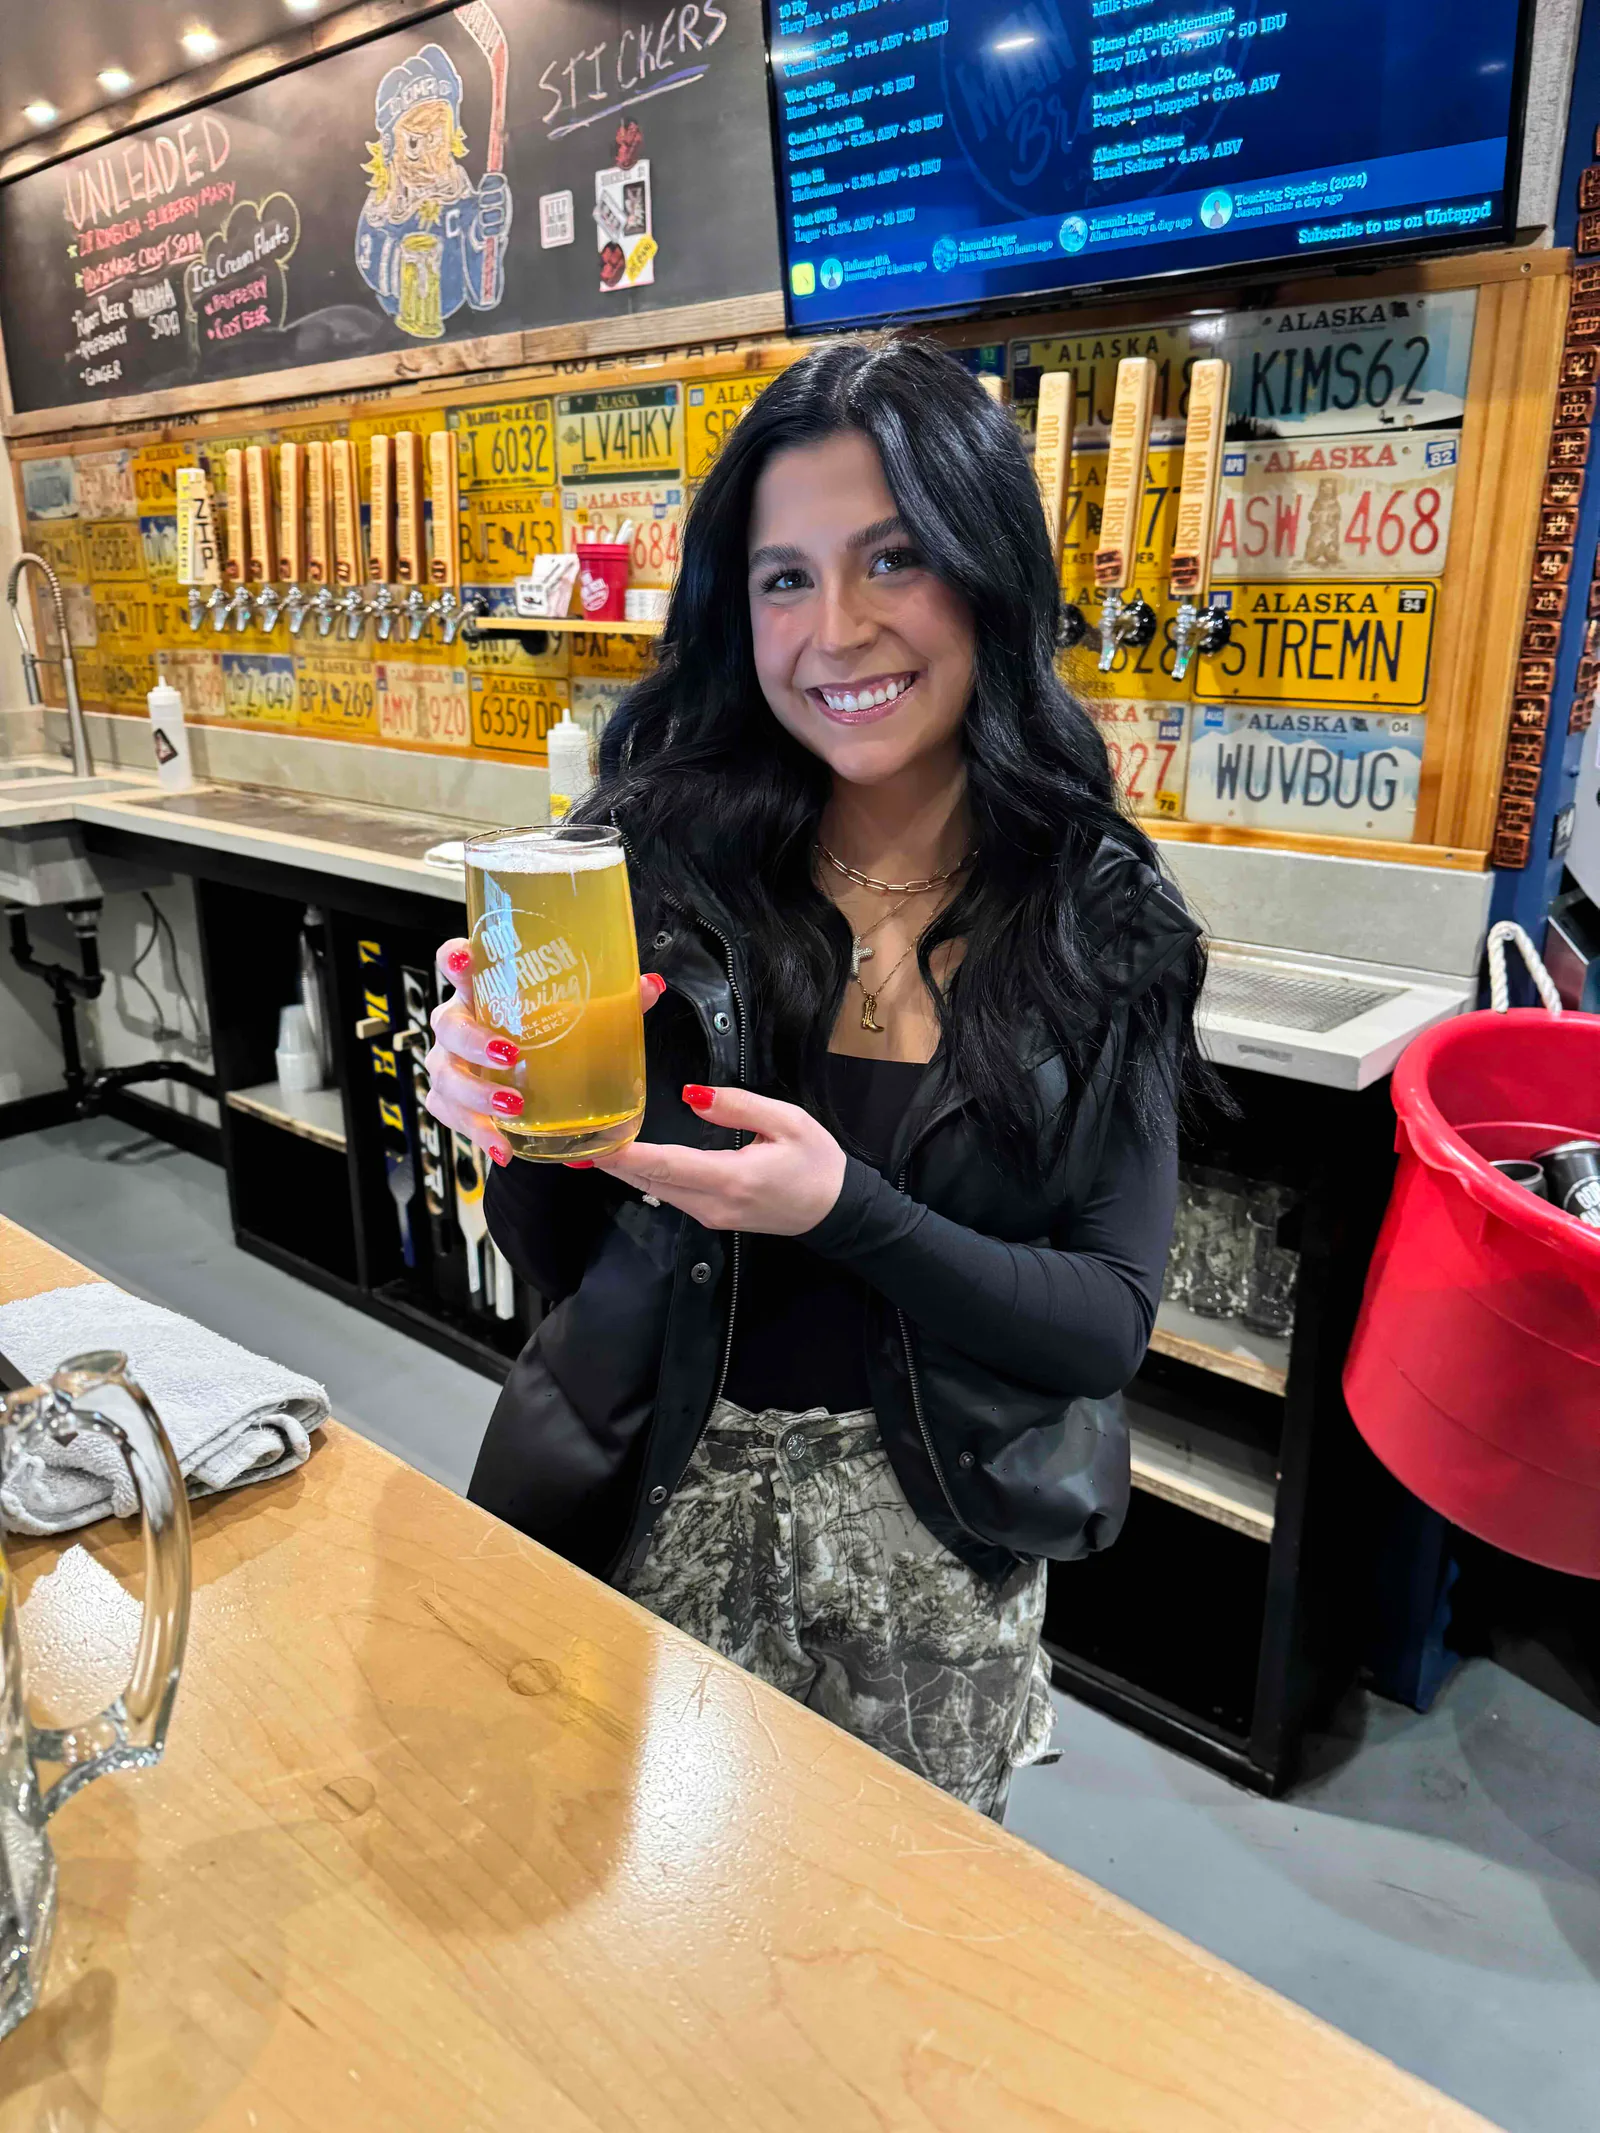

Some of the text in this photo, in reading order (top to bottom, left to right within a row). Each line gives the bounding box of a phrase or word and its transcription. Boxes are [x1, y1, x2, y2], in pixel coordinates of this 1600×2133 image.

[779, 1, 808, 19] 10 Ply
[780, 19, 804, 36] Hazy
[805, 12, 824, 28] IPA
[1092, 1, 1121, 18] Milk
[783, 19, 949, 78] Vanilla Porter 5.7% ABV 24 IBU
[1092, 6, 1236, 56] Plane of Enlightenment
[1092, 13, 1288, 74] Hazy IPA 6.7% ABV 50 IBU
[539, 0, 728, 125] STICKERS
[826, 92, 850, 111] 5.5%
[851, 86, 874, 104] ABV
[896, 74, 916, 93] IBU
[1092, 87, 1134, 110] Double
[1136, 77, 1176, 100] Shovel
[1177, 70, 1213, 90] Cider
[1092, 72, 1282, 128] Forget me hopped 6.6% ABV
[788, 127, 816, 146] Coach
[876, 123, 900, 142] ABV
[923, 113, 944, 132] IBU
[1092, 134, 1185, 164] Alaskan Seltzer
[1092, 138, 1244, 181] Hard Seltzer 4.5% ABV
[65, 116, 230, 230] UNLEADED
[876, 167, 900, 186] ABV
[921, 157, 942, 176] IBU
[1329, 172, 1368, 193] (2024)
[446, 209, 460, 238] C
[794, 228, 822, 244] Lager
[852, 214, 876, 232] ABV
[896, 206, 916, 224] IBU
[1298, 201, 1492, 245] Subscribe to us on Untappd
[138, 234, 172, 268] CRAFT
[172, 229, 204, 259] SODA
[192, 264, 216, 293] Ice
[98, 294, 128, 324] BEER
[1276, 303, 1387, 334] ALASKA
[1058, 334, 1160, 364] ALASKA
[716, 382, 768, 405] ALAS
[1250, 335, 1431, 418] KIMS62
[594, 394, 640, 412] ALASKA
[1115, 402, 1137, 440] ODD
[580, 407, 676, 463] LV4HKY
[1189, 404, 1212, 442] ODD
[492, 424, 550, 475] 6032
[1109, 446, 1132, 490] MAN
[1263, 444, 1454, 474] ALASKA 82
[1182, 450, 1208, 494] MAN
[472, 498, 536, 515] ALASKA
[586, 493, 653, 510] ALASKA
[1104, 496, 1127, 544] RUSH
[192, 498, 214, 570] ZIP
[1174, 502, 1203, 550] RUSH
[1213, 493, 1303, 560] ASW
[1344, 487, 1442, 557] 468
[460, 522, 499, 565] BJE
[634, 521, 678, 569] 684
[1250, 592, 1422, 614] ALASKA 94
[1220, 618, 1404, 683] STREMN
[343, 680, 374, 718] 269
[491, 680, 548, 698] ALASKA
[429, 696, 467, 736] 920
[1161, 726, 1180, 737] AUG
[1206, 710, 1410, 734] AUG ALASKA 04
[1217, 742, 1399, 812] WUVBUG
[480, 924, 522, 963] ODD
[472, 936, 579, 1008] MAN RUSH
[488, 974, 583, 1029] Brewing
